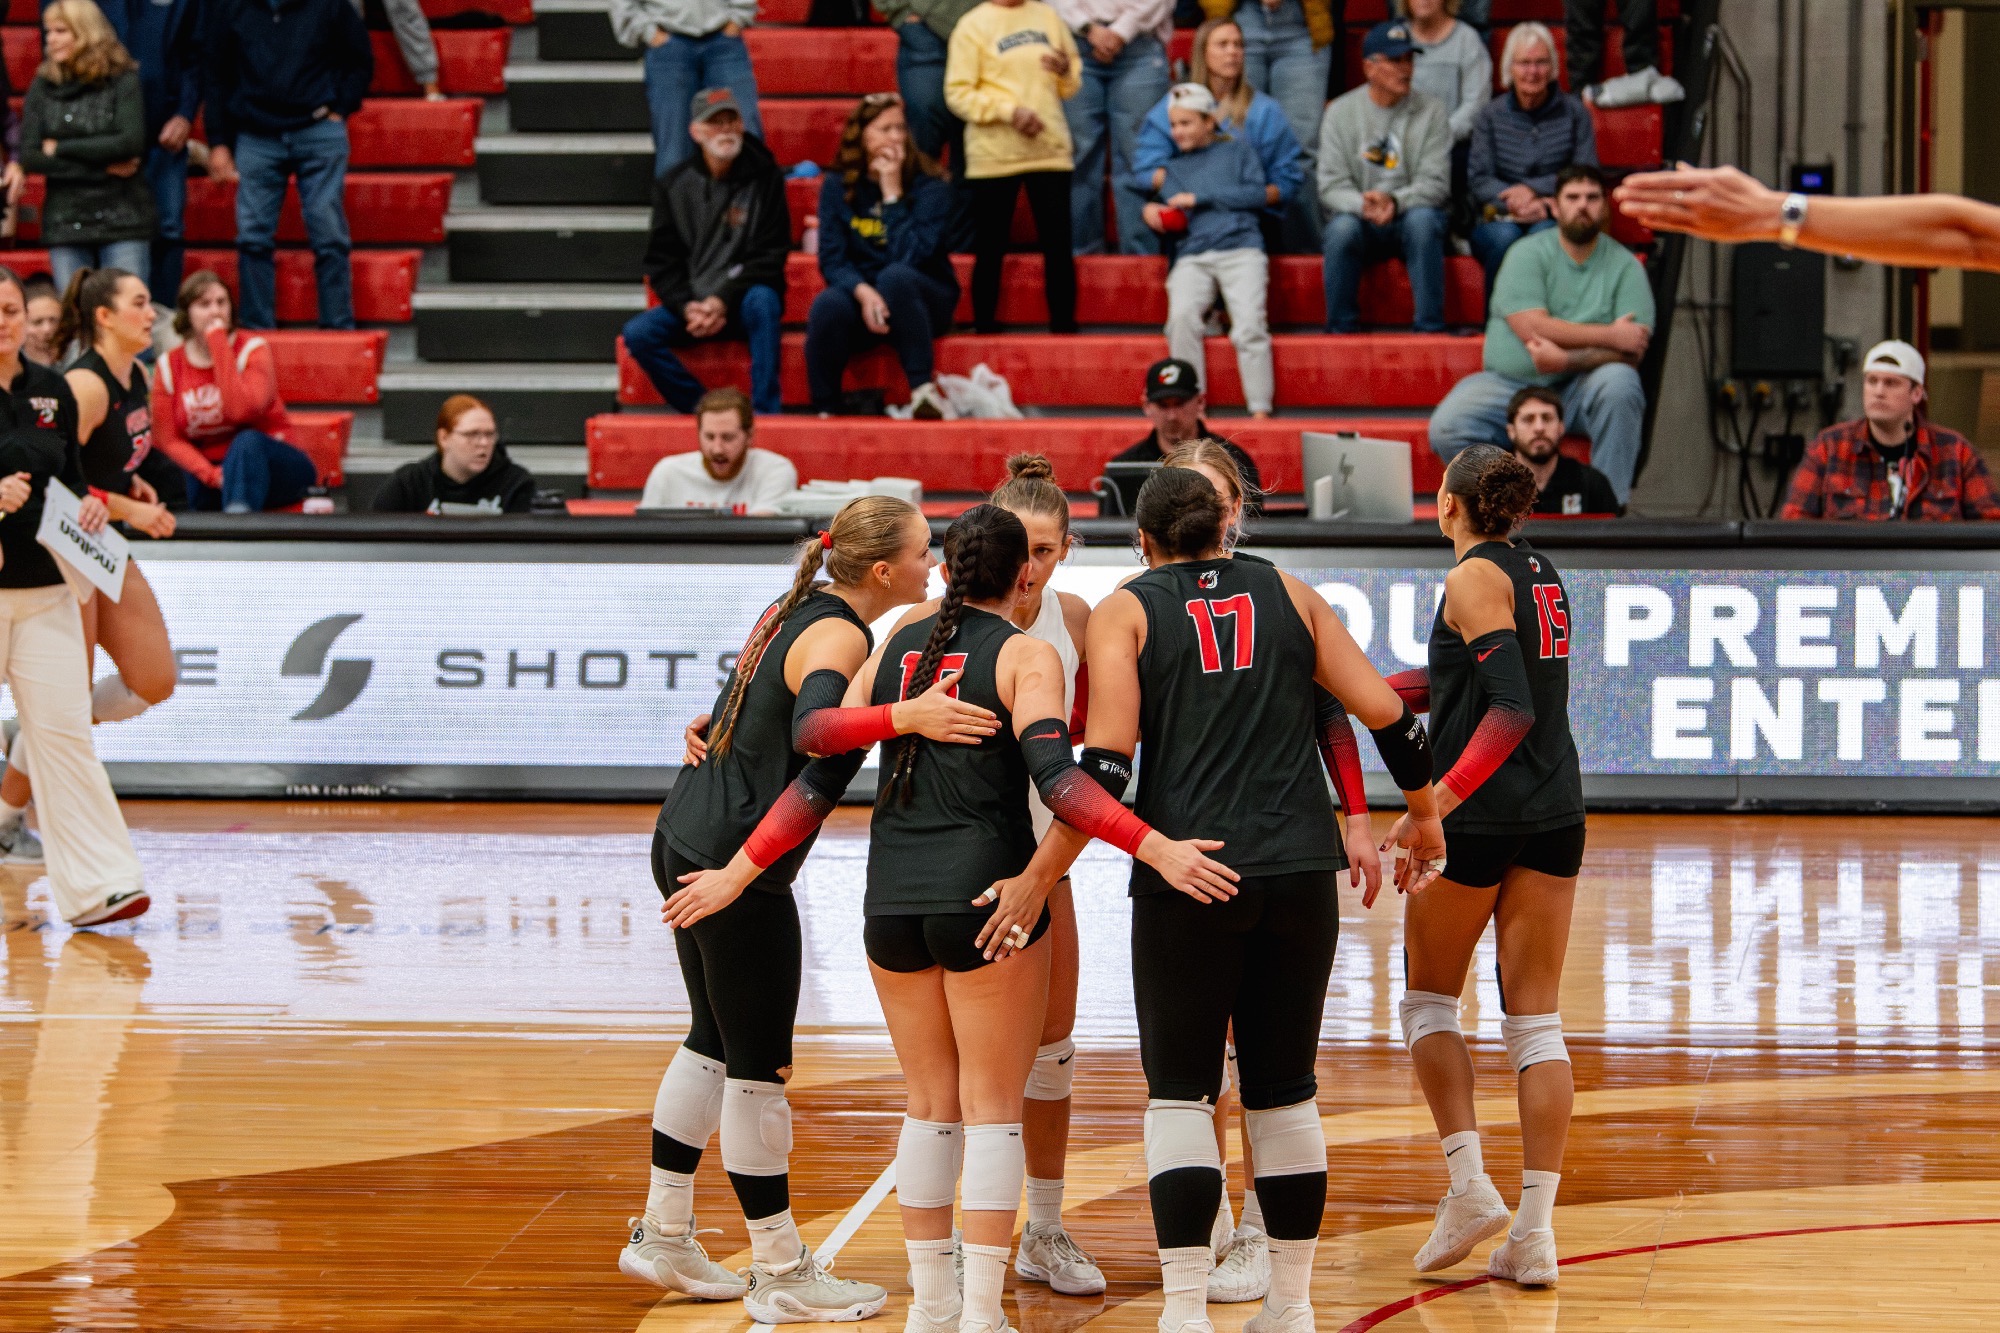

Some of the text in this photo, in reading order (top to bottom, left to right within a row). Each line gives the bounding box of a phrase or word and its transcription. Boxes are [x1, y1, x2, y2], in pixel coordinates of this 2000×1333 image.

[60, 519, 117, 575] molten
[1185, 592, 1255, 674] 17
[1532, 583, 1570, 660] 15
[1603, 584, 1984, 669] PREMI
